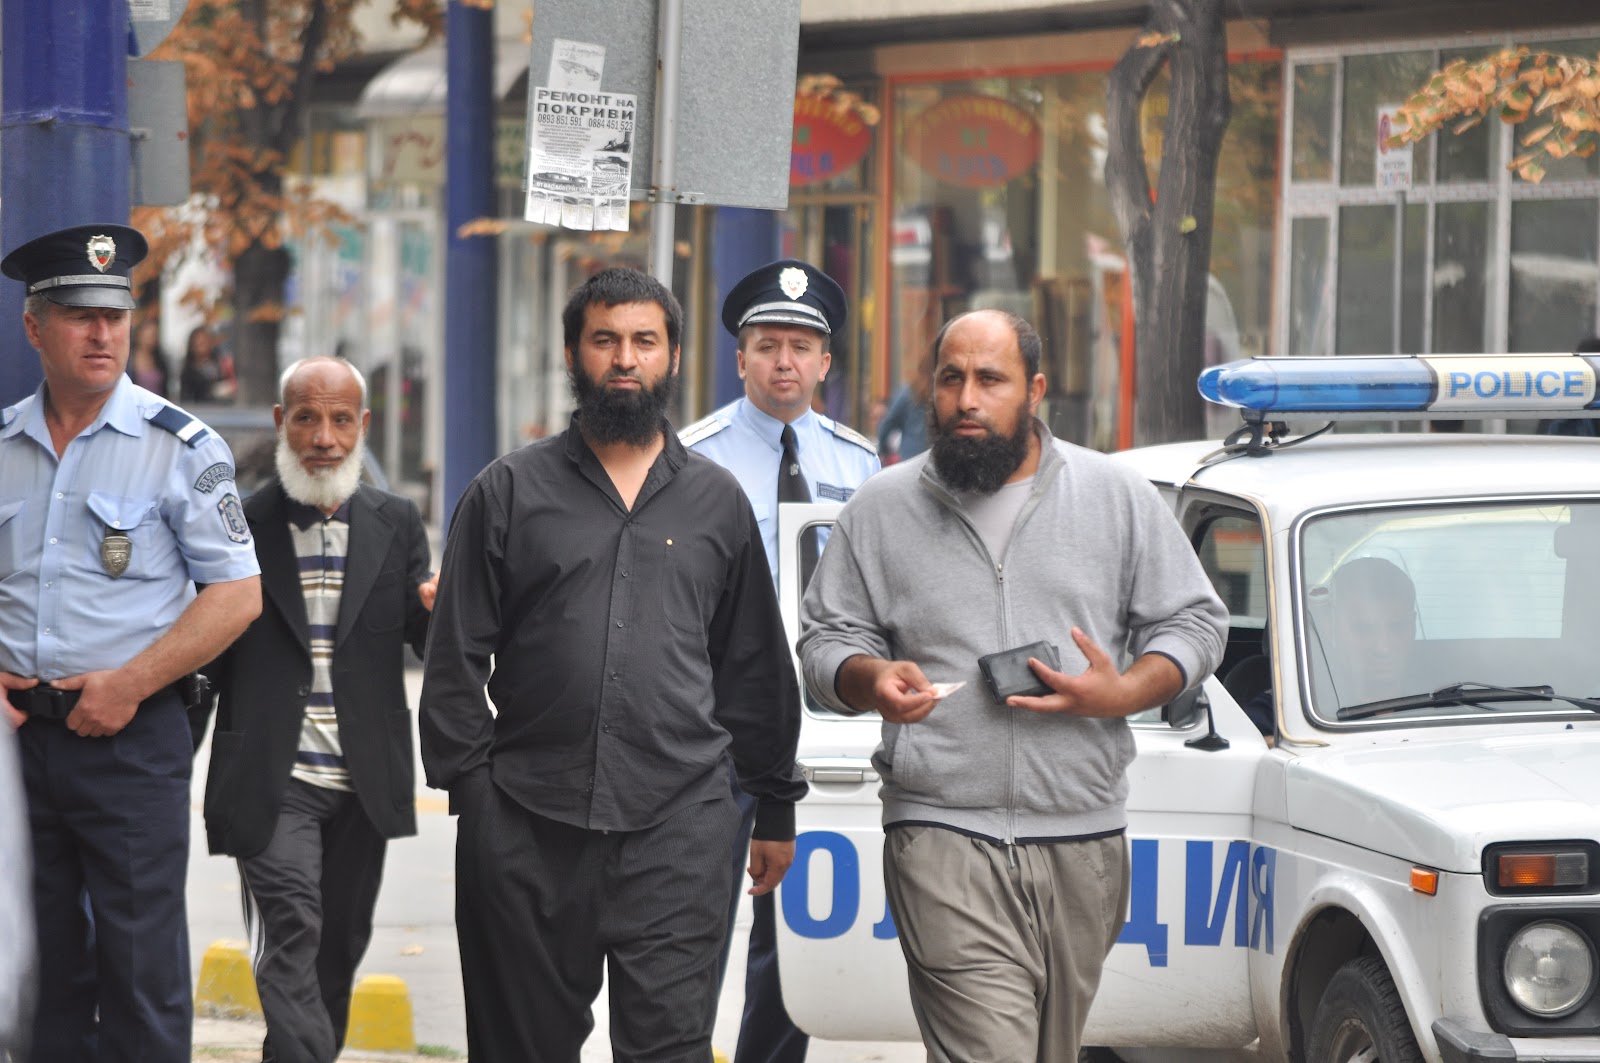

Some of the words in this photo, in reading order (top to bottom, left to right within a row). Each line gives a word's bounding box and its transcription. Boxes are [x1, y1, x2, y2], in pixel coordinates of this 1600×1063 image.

[538, 90, 612, 105] РЕМОНТ
[616, 99, 635, 108] НА
[537, 103, 634, 120] ПОКРИВИ
[538, 113, 554, 125] 0893
[556, 115, 568, 126] 851
[570, 117, 582, 127] 591
[588, 118, 605, 128] 0884
[607, 119, 619, 130] 451
[620, 121, 634, 131] 523
[1449, 371, 1584, 398] POLICE
